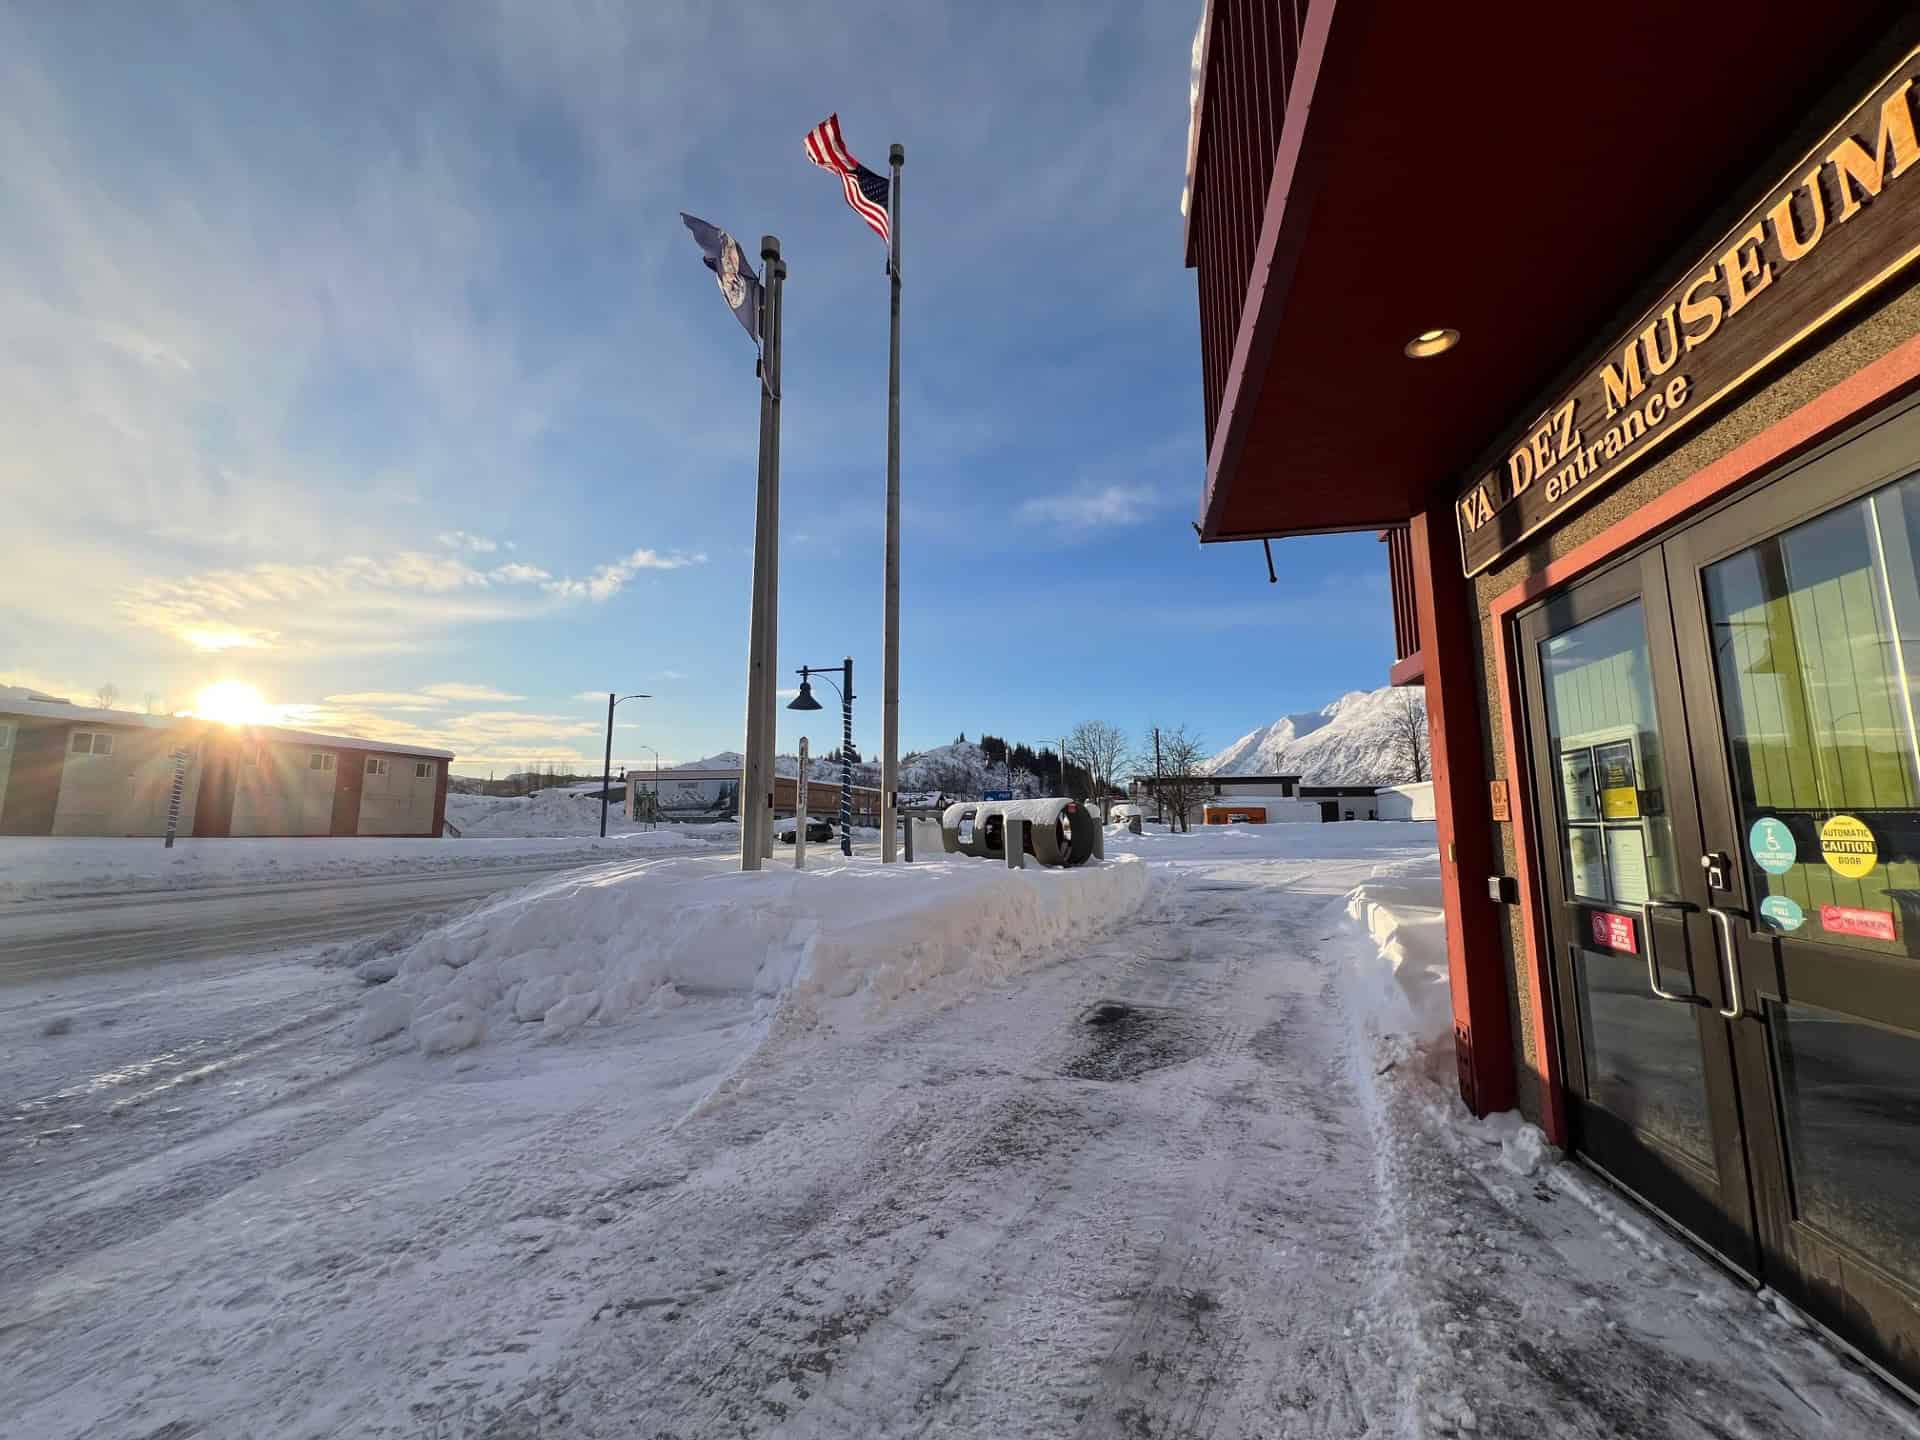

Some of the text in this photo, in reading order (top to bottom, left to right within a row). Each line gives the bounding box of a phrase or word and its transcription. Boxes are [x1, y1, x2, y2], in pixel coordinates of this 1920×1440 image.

[1600, 78, 1920, 420] MUSEUM
[1544, 374, 1688, 503] entrance
[1823, 828, 1870, 838] AUTOMATIC
[1822, 840, 1873, 853] CAUTION
[1838, 856, 1862, 865] DOOR
